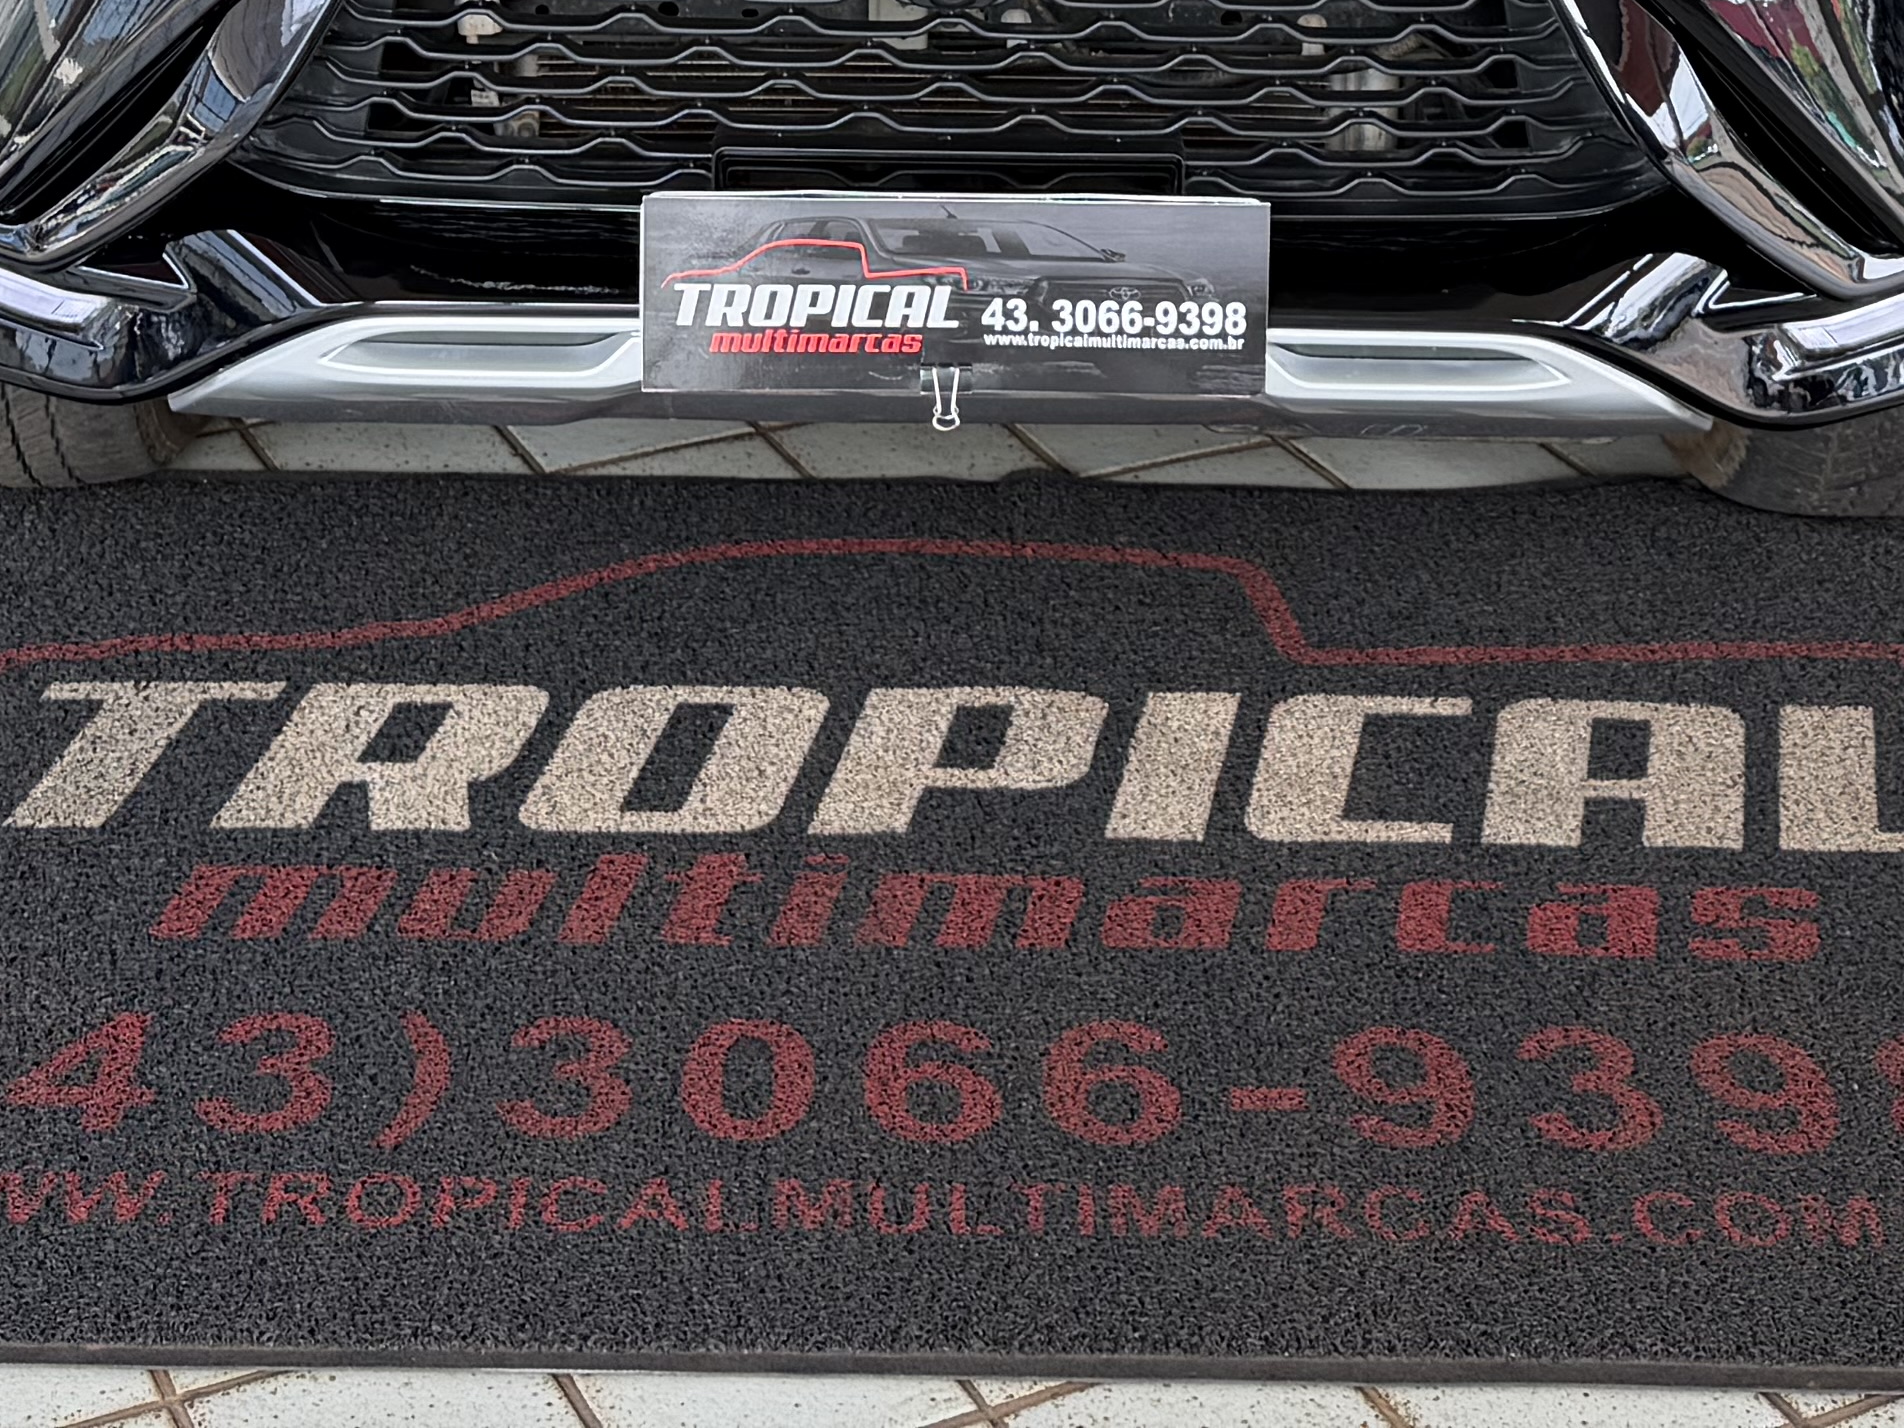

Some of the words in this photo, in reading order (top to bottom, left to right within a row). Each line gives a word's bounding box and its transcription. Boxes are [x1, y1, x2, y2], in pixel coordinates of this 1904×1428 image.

[673, 282, 960, 328] TROPICAL
[981, 297, 1039, 332] 43.
[1051, 298, 1247, 336] 3066-9398
[709, 328, 923, 353] multimarcas
[147, 851, 1822, 962] multimarcas
